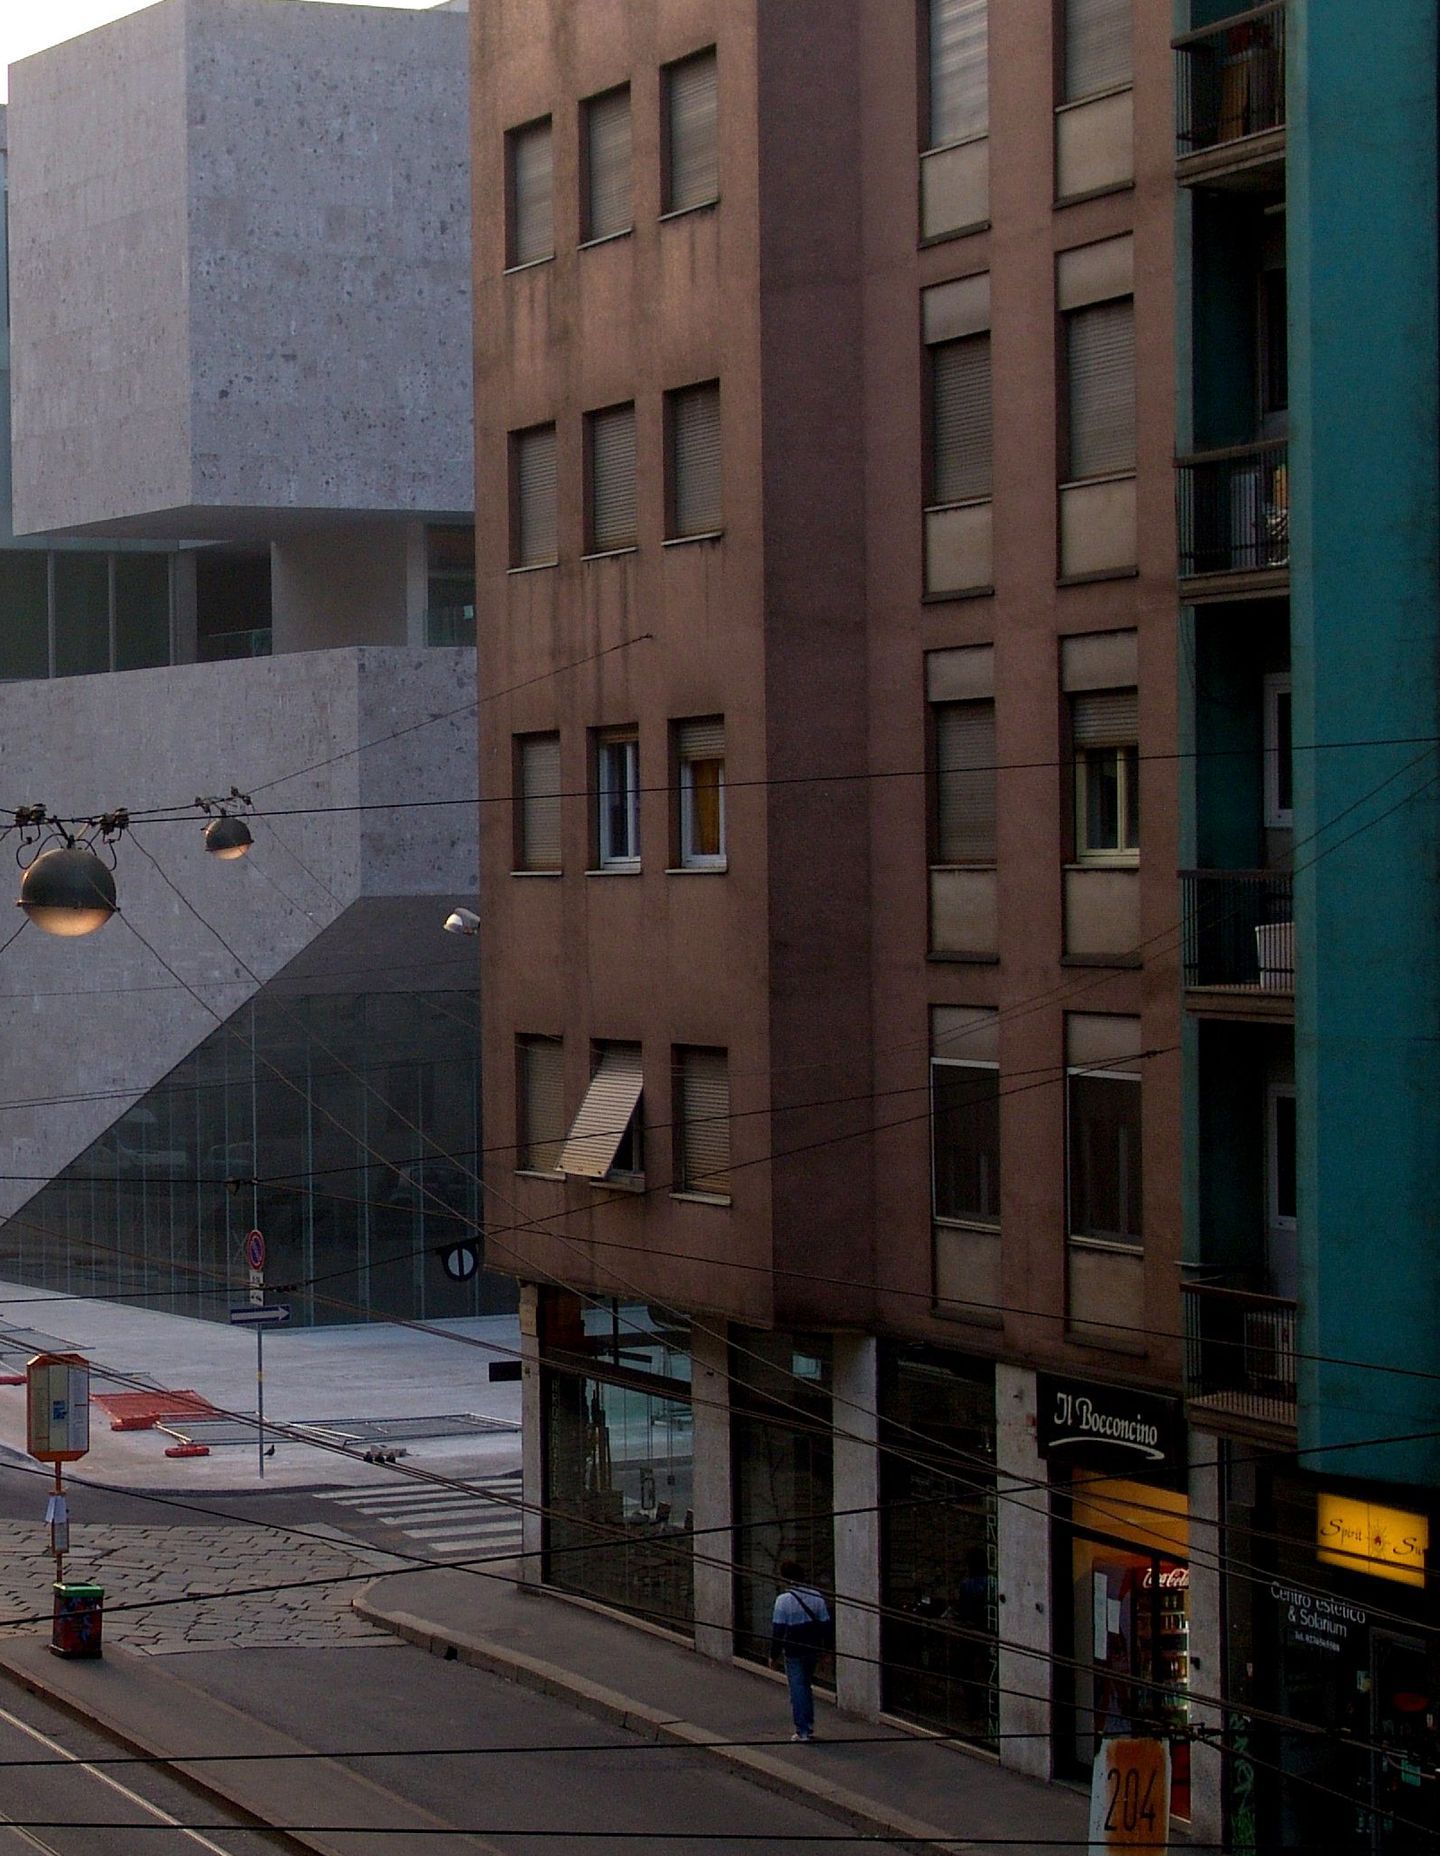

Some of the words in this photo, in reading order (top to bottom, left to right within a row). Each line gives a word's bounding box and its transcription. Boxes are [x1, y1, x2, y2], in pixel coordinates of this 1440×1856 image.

[1054, 1391, 1072, 1426] Il
[1075, 1397, 1158, 1446] Bocconcino
[1320, 1518, 1362, 1546] Spirit
[1270, 1580, 1312, 1608] Centro
[1315, 1597, 1366, 1624] estetico
[1287, 1604, 1296, 1622] &
[1299, 1608, 1347, 1638] Solarium
[1105, 1767, 1157, 1832] 204
